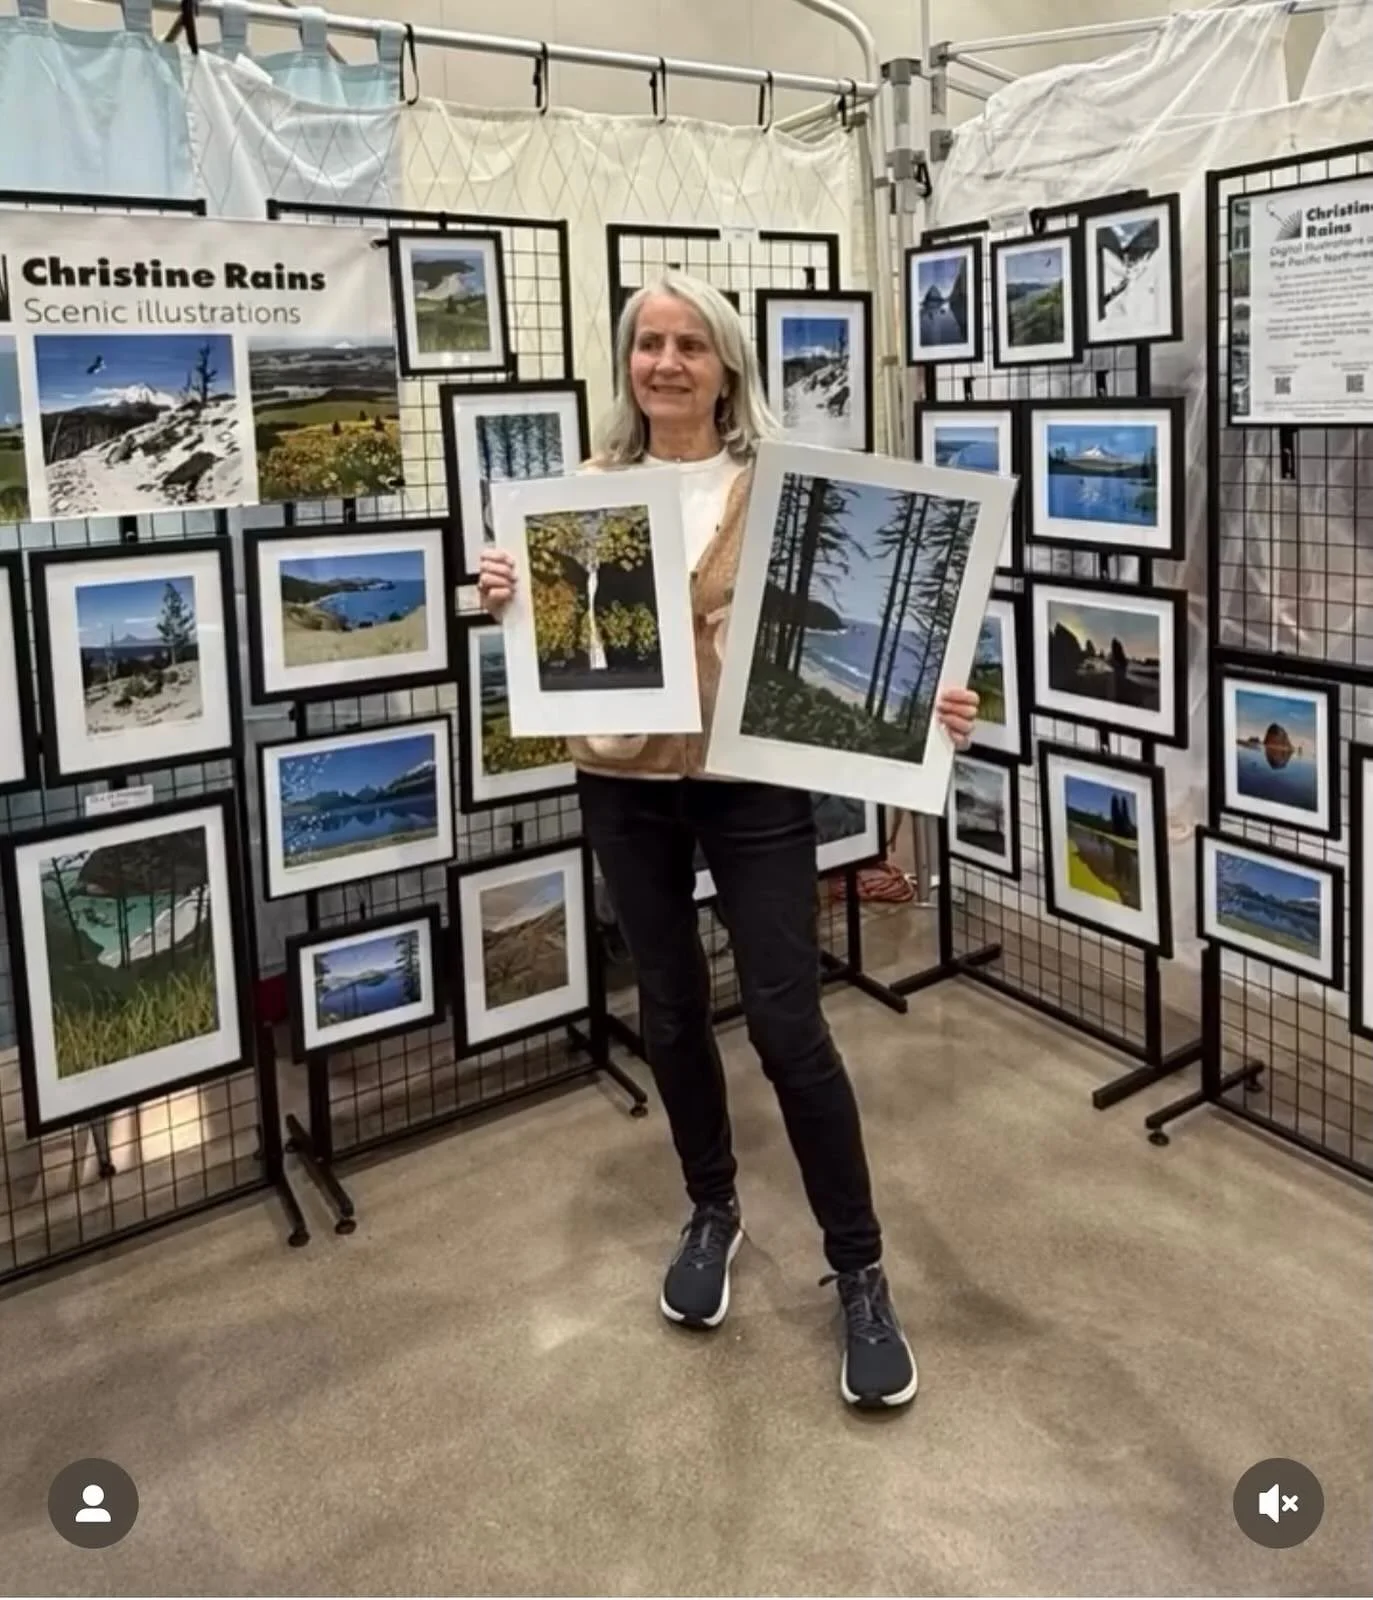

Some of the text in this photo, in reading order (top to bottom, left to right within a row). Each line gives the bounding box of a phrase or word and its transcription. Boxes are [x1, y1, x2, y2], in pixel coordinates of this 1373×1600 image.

[1307, 222, 1351, 239] Rains
[1269, 243, 1302, 257] Digital
[1269, 260, 1286, 269] the
[1288, 254, 1321, 267] Pacific
[22, 256, 325, 291] Christine Rains
[24, 298, 302, 325] Scenic illustrations
